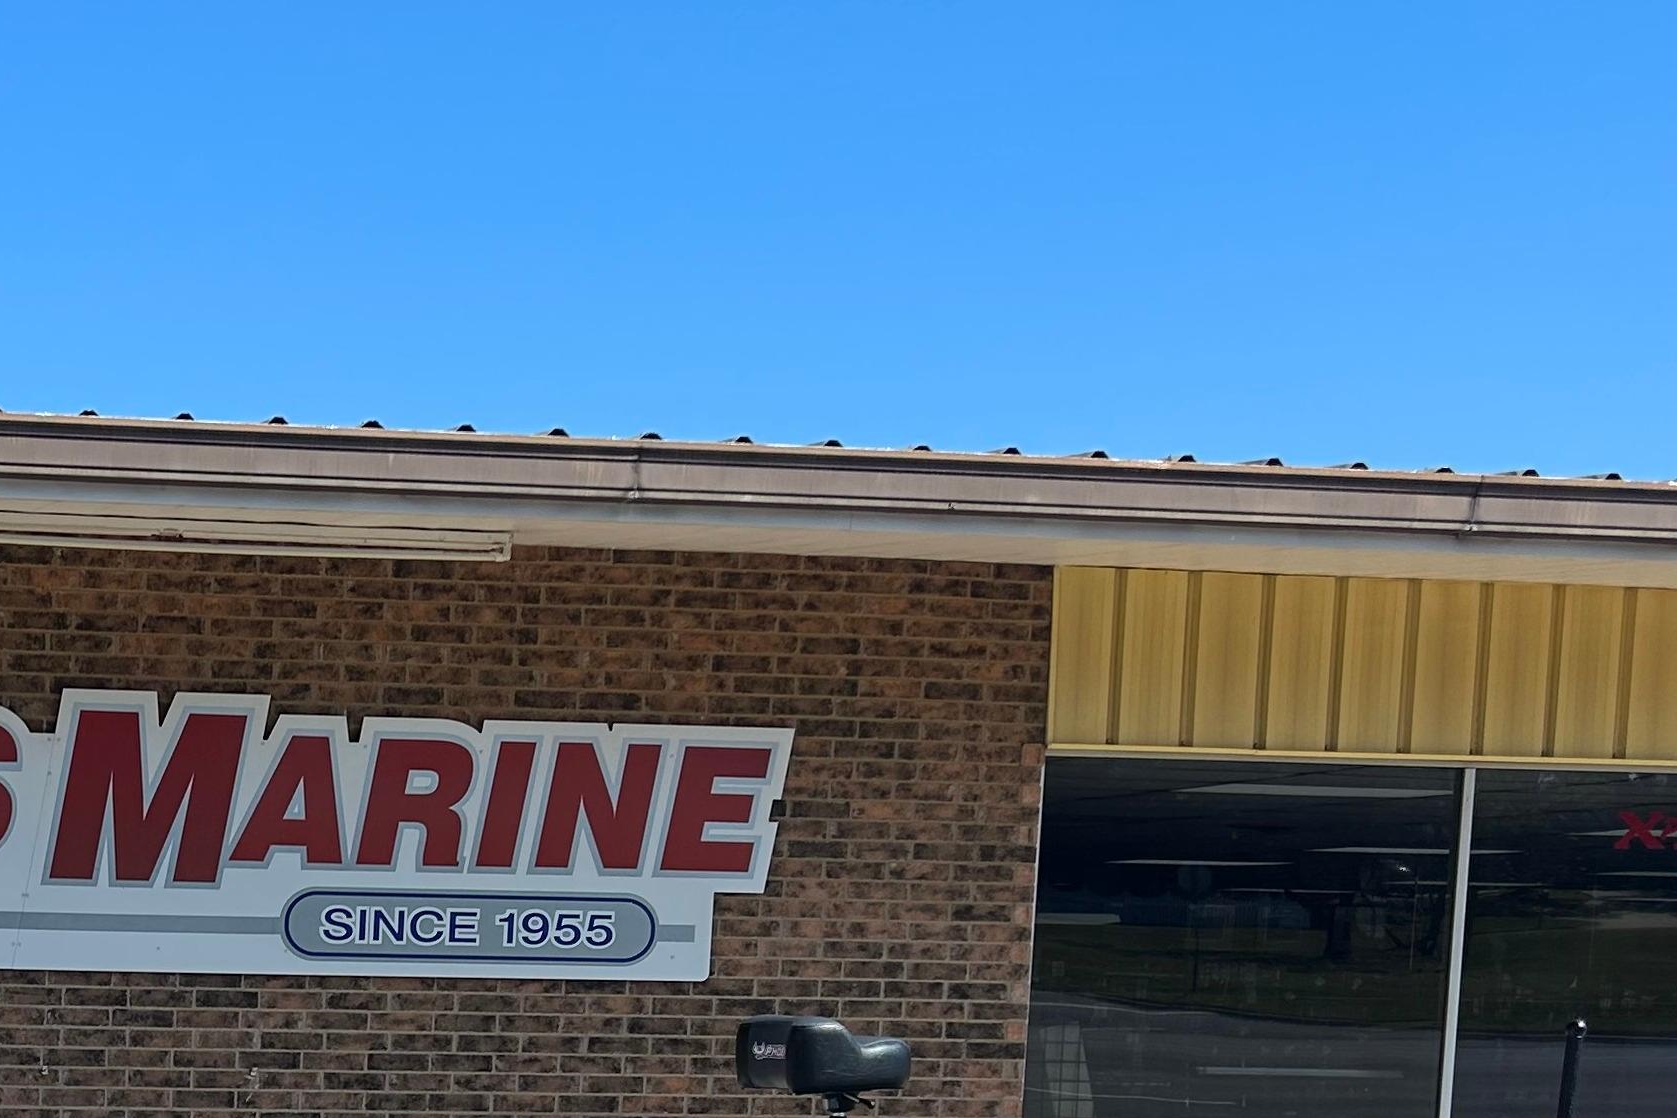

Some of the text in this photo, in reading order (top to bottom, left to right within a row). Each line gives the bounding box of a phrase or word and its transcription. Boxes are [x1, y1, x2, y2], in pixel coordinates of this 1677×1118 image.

[49, 709, 771, 884] MARINE
[321, 906, 616, 950] SINCE 1955
